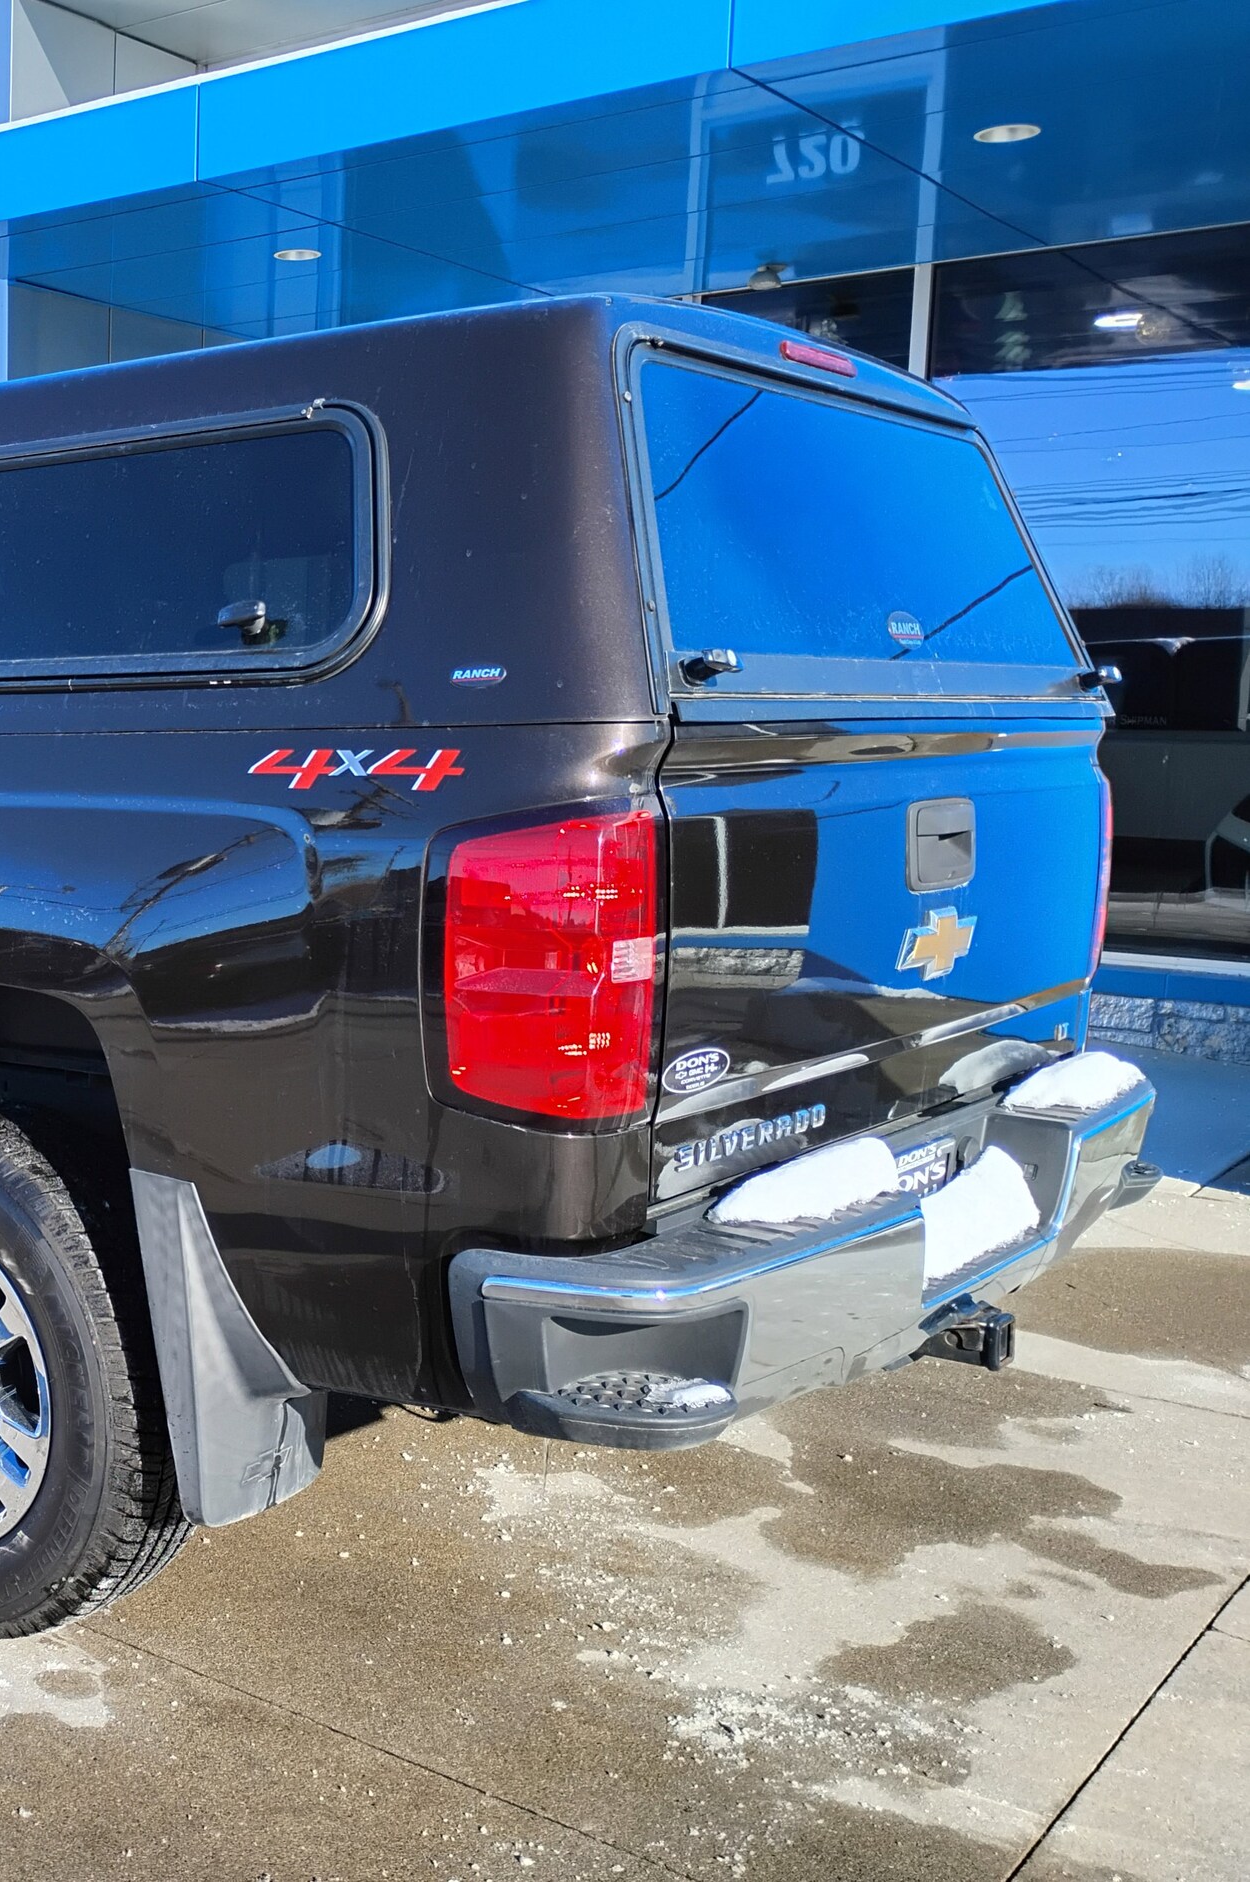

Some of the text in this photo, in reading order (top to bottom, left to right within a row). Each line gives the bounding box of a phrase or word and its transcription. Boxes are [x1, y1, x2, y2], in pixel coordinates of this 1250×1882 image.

[891, 622, 921, 636] RANCH
[452, 667, 502, 680] RANCH
[675, 1052, 720, 1072] DON'S
[674, 1103, 826, 1172] SILVERADO
[898, 1160, 946, 1192] ON'S
